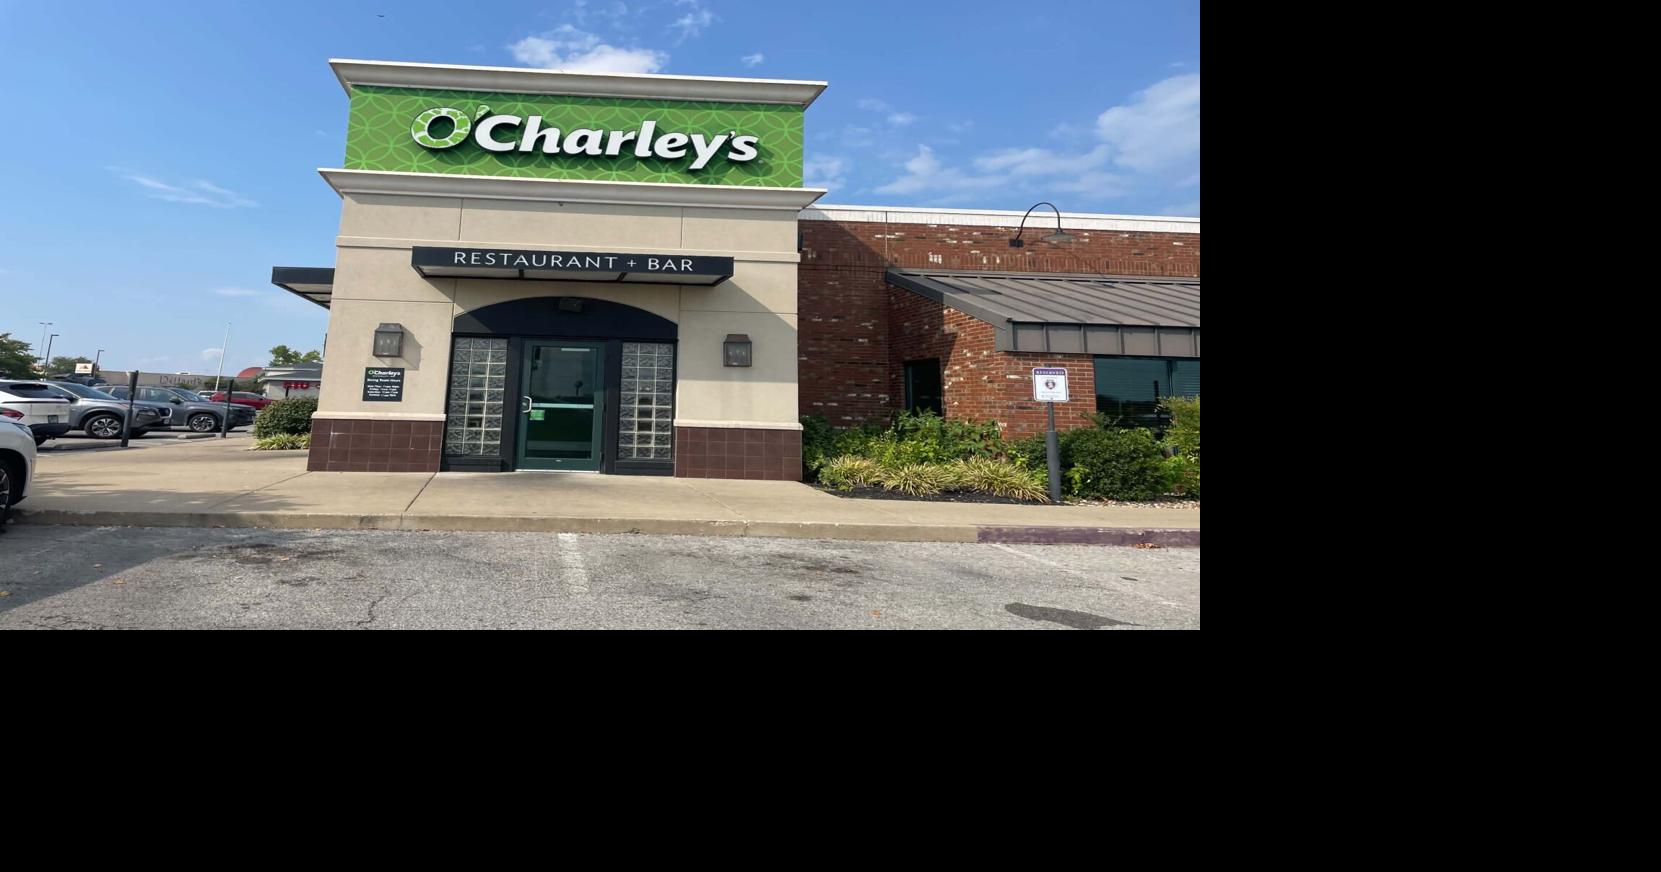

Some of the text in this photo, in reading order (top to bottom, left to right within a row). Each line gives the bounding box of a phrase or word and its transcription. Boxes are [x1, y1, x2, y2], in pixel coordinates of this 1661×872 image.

[410, 105, 759, 170] O'Charley's
[453, 250, 693, 272] RESTAURANT + BAR
